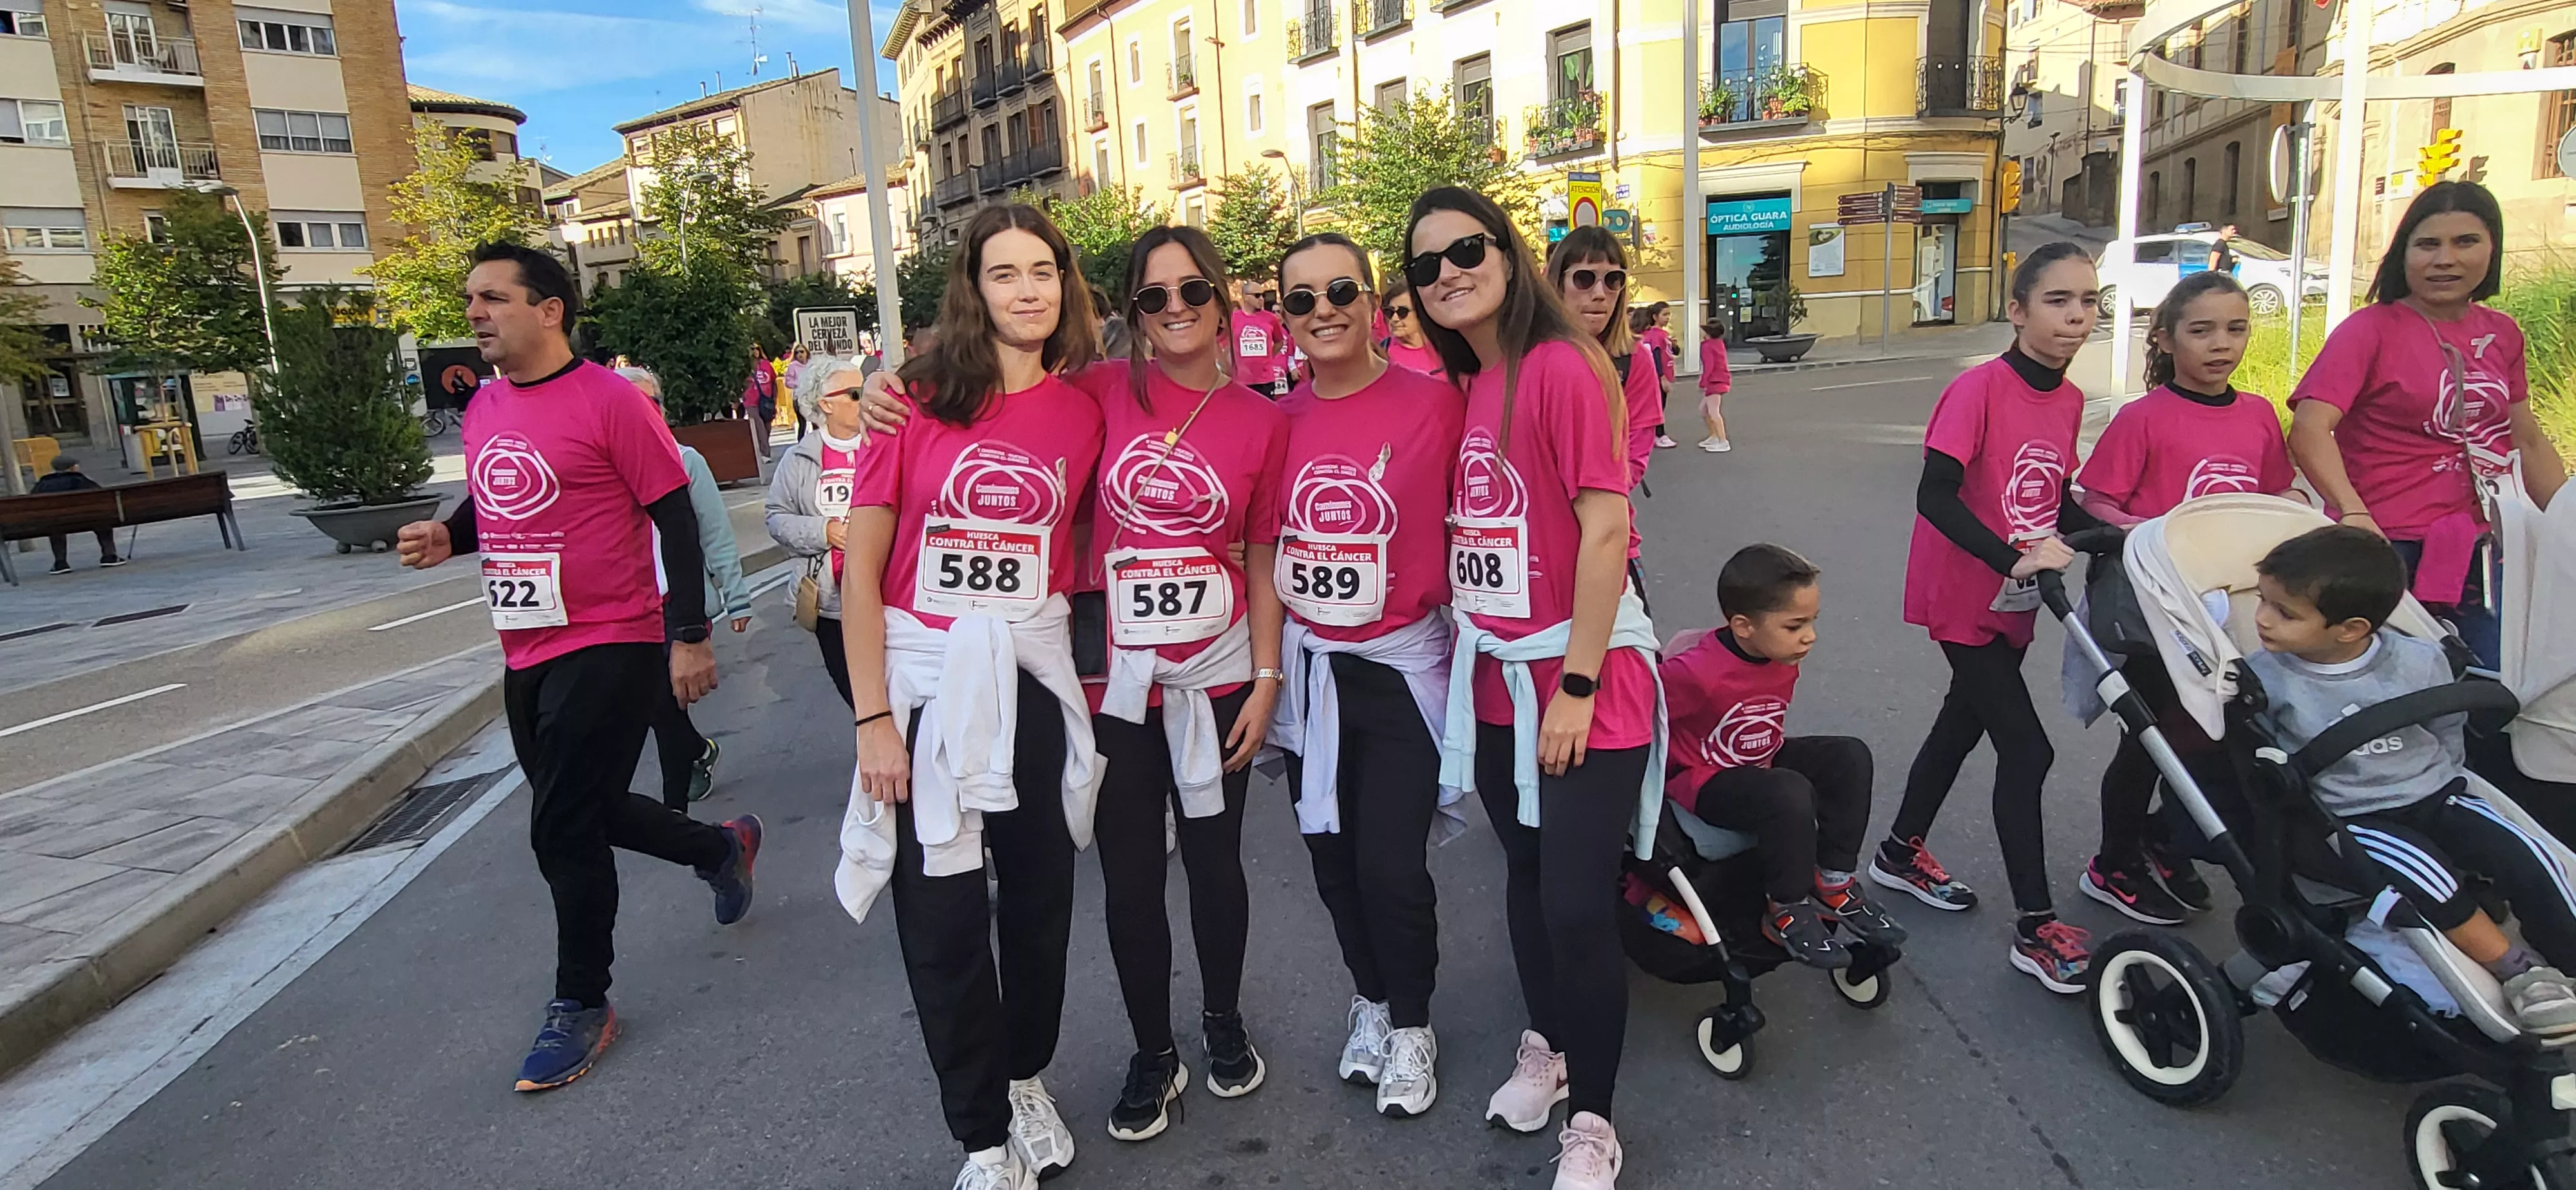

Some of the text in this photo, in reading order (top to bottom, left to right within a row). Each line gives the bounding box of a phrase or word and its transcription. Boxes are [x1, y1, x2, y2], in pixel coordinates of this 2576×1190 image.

[1710, 211, 1787, 223] ÓPTICA GUARA
[1723, 220, 1774, 231] AUDIOLOGÍA
[808, 316, 848, 328] LA MEJOR
[811, 328, 848, 339] CERVEZA
[808, 339, 853, 351] DEL NDO
[967, 531, 999, 541] HUESCA
[1477, 536, 1513, 547] CÁNCER
[929, 536, 1034, 554] CONTRA EL CÁNCER
[1307, 543, 1337, 552] HUESCA
[1286, 545, 1372, 562] CONTRA EL CÁNCER
[511, 567, 546, 576] CÁNCER
[939, 552, 1021, 593] 588
[1121, 565, 1218, 579] CONTRA EL CÁNCER
[1456, 550, 1504, 589] 608
[1291, 562, 1360, 600] 589
[1133, 580, 1208, 618] 587
